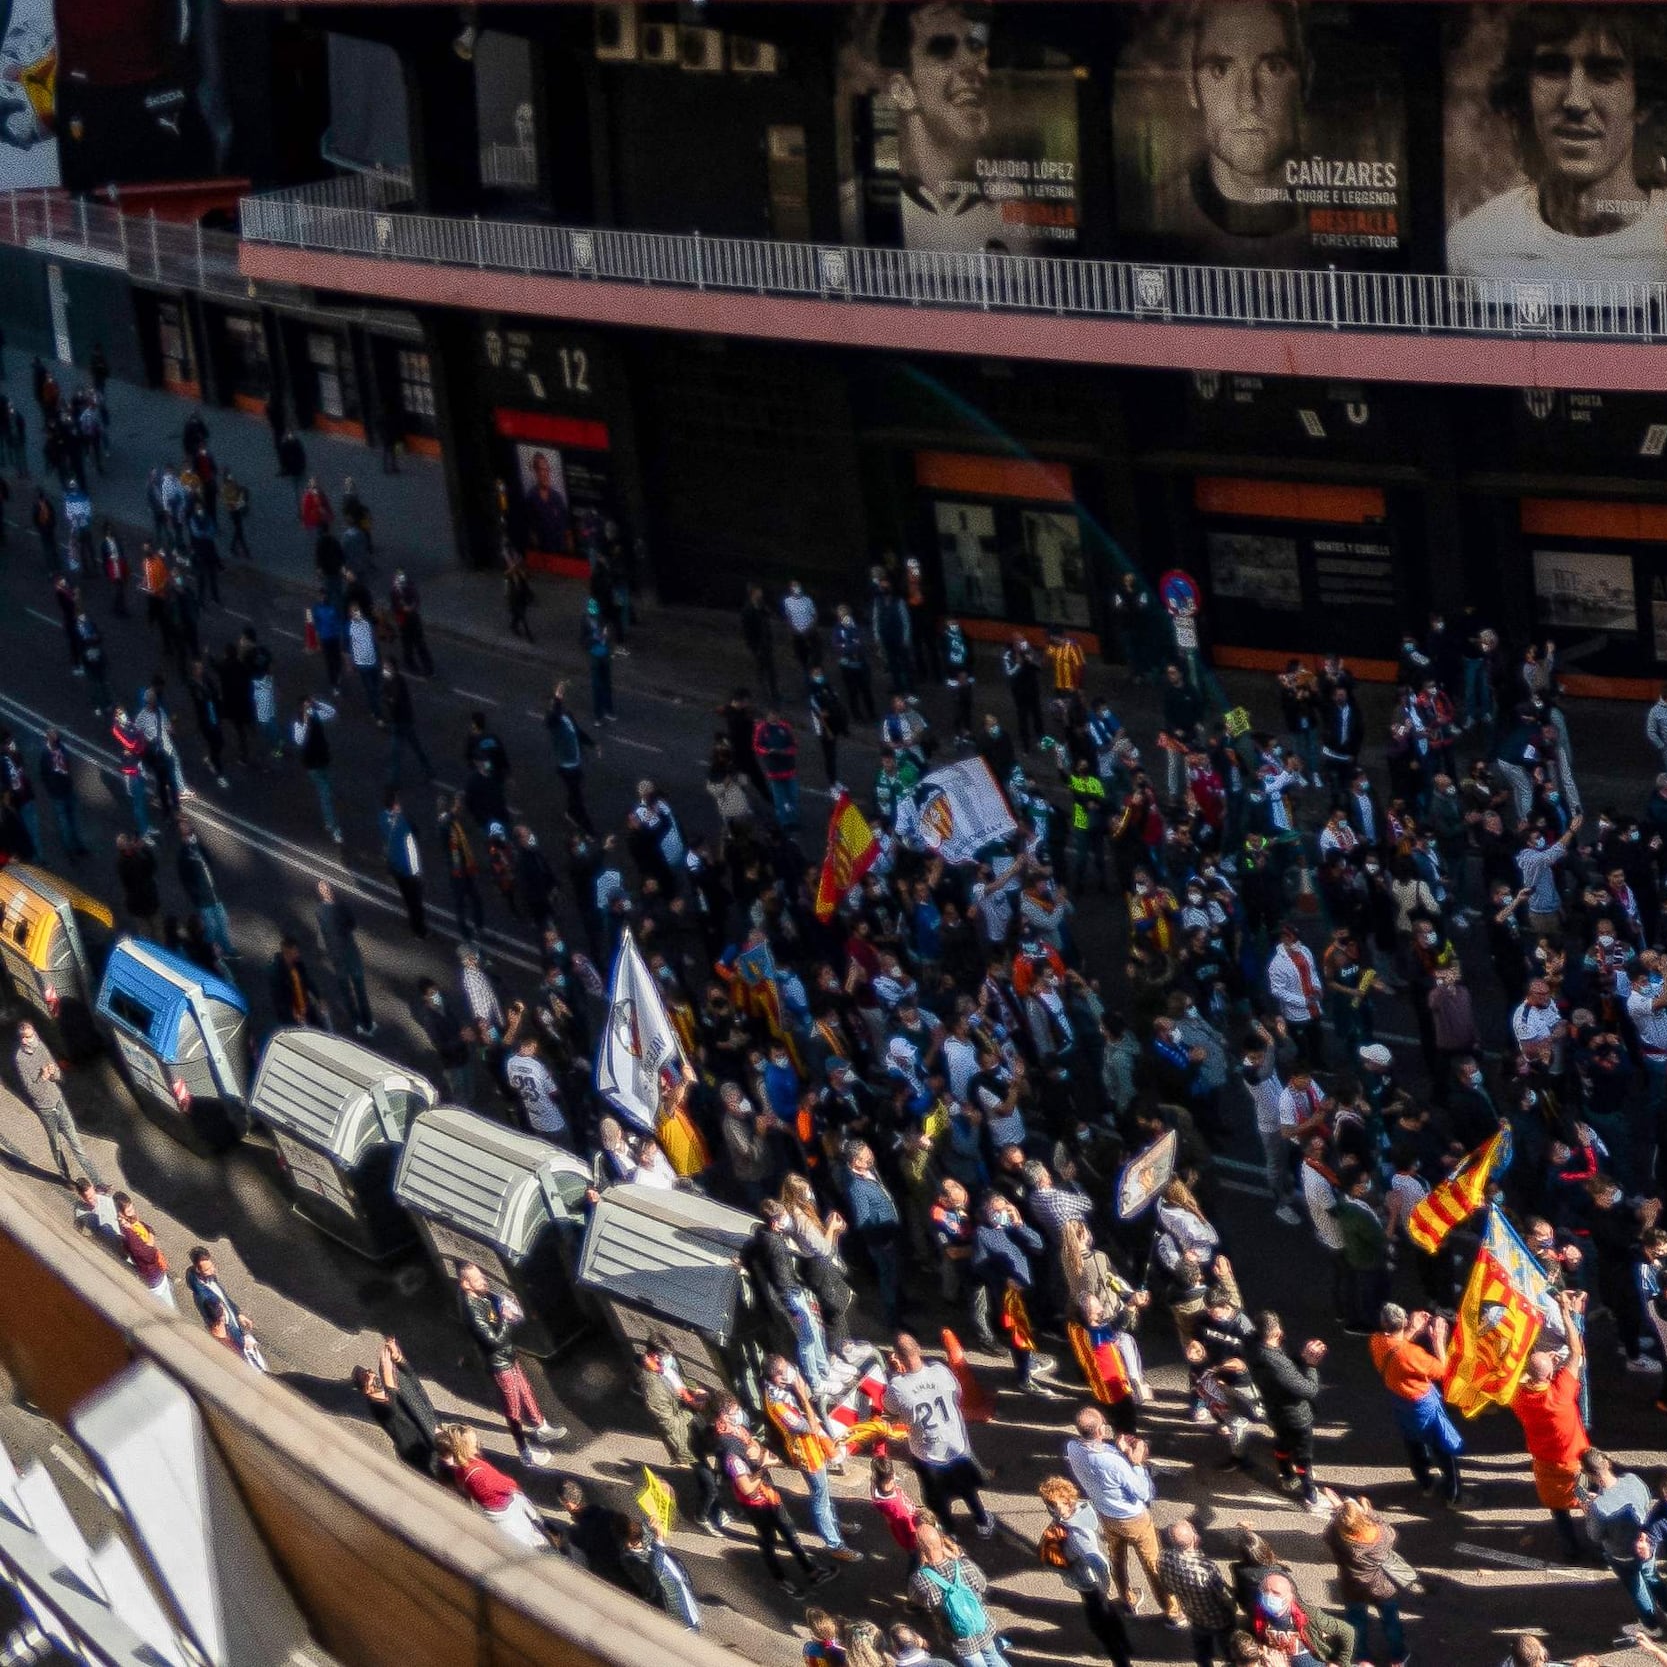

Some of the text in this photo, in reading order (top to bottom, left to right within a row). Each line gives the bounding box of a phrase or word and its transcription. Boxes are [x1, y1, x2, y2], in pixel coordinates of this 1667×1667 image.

[976, 158, 1029, 179] CLAUDIO
[1285, 155, 1398, 188] CAÑIZARES
[1296, 189, 1331, 204] CUORE
[1333, 190, 1340, 204] E
[558, 347, 593, 394] 12
[1570, 394, 1603, 407] PORTA
[914, 1395, 951, 1431] 21
